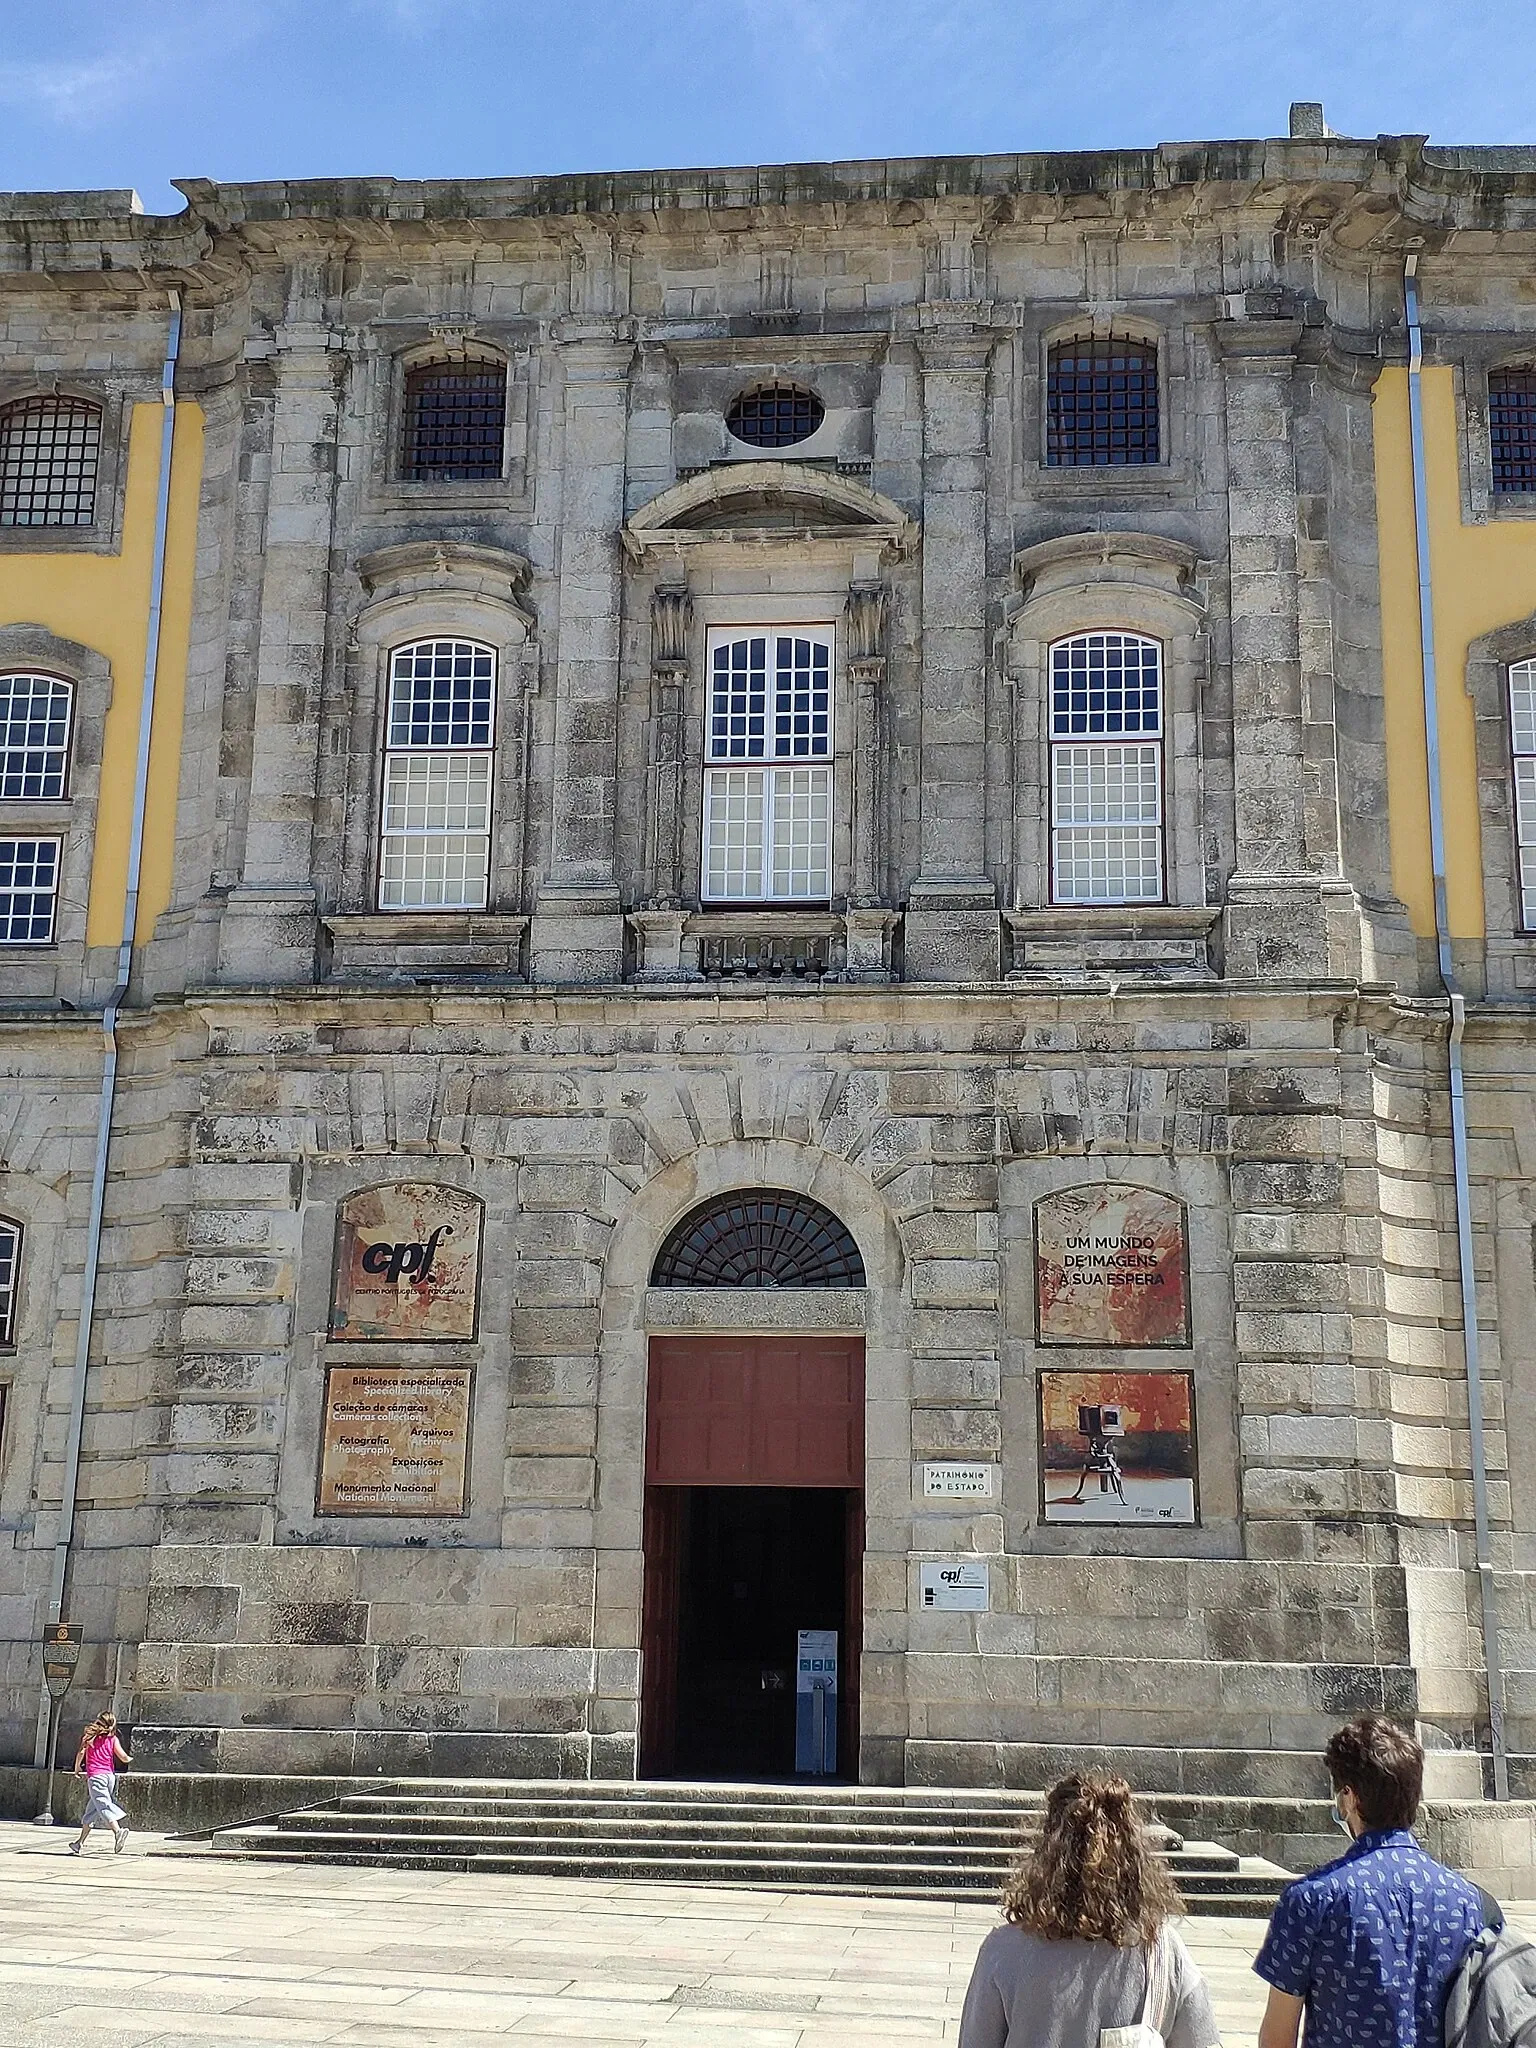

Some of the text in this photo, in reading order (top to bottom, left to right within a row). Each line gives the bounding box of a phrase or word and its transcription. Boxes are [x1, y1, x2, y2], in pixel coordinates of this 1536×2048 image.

[1066, 1237, 1155, 1249] UM MUNDO
[1064, 1255, 1158, 1268] DE IMAGENS
[1073, 1273, 1103, 1285] SUA
[1107, 1273, 1165, 1286] ESPERA
[352, 1376, 465, 1387] Biblioteca especializada
[419, 1385, 453, 1397] library
[333, 1402, 371, 1413] Coleção
[373, 1402, 386, 1412] de
[333, 1411, 422, 1421] Cameras collection
[410, 1426, 454, 1439] Arquivos
[340, 1435, 390, 1447] Fotografia
[332, 1444, 396, 1457] Photography
[391, 1456, 444, 1469] Exposições
[930, 1470, 984, 1479] PATRIMÓNIO
[334, 1481, 437, 1493] Monumento Nacional
[930, 1482, 985, 1491] DO ESTADO
[337, 1493, 433, 1502] National Monument
